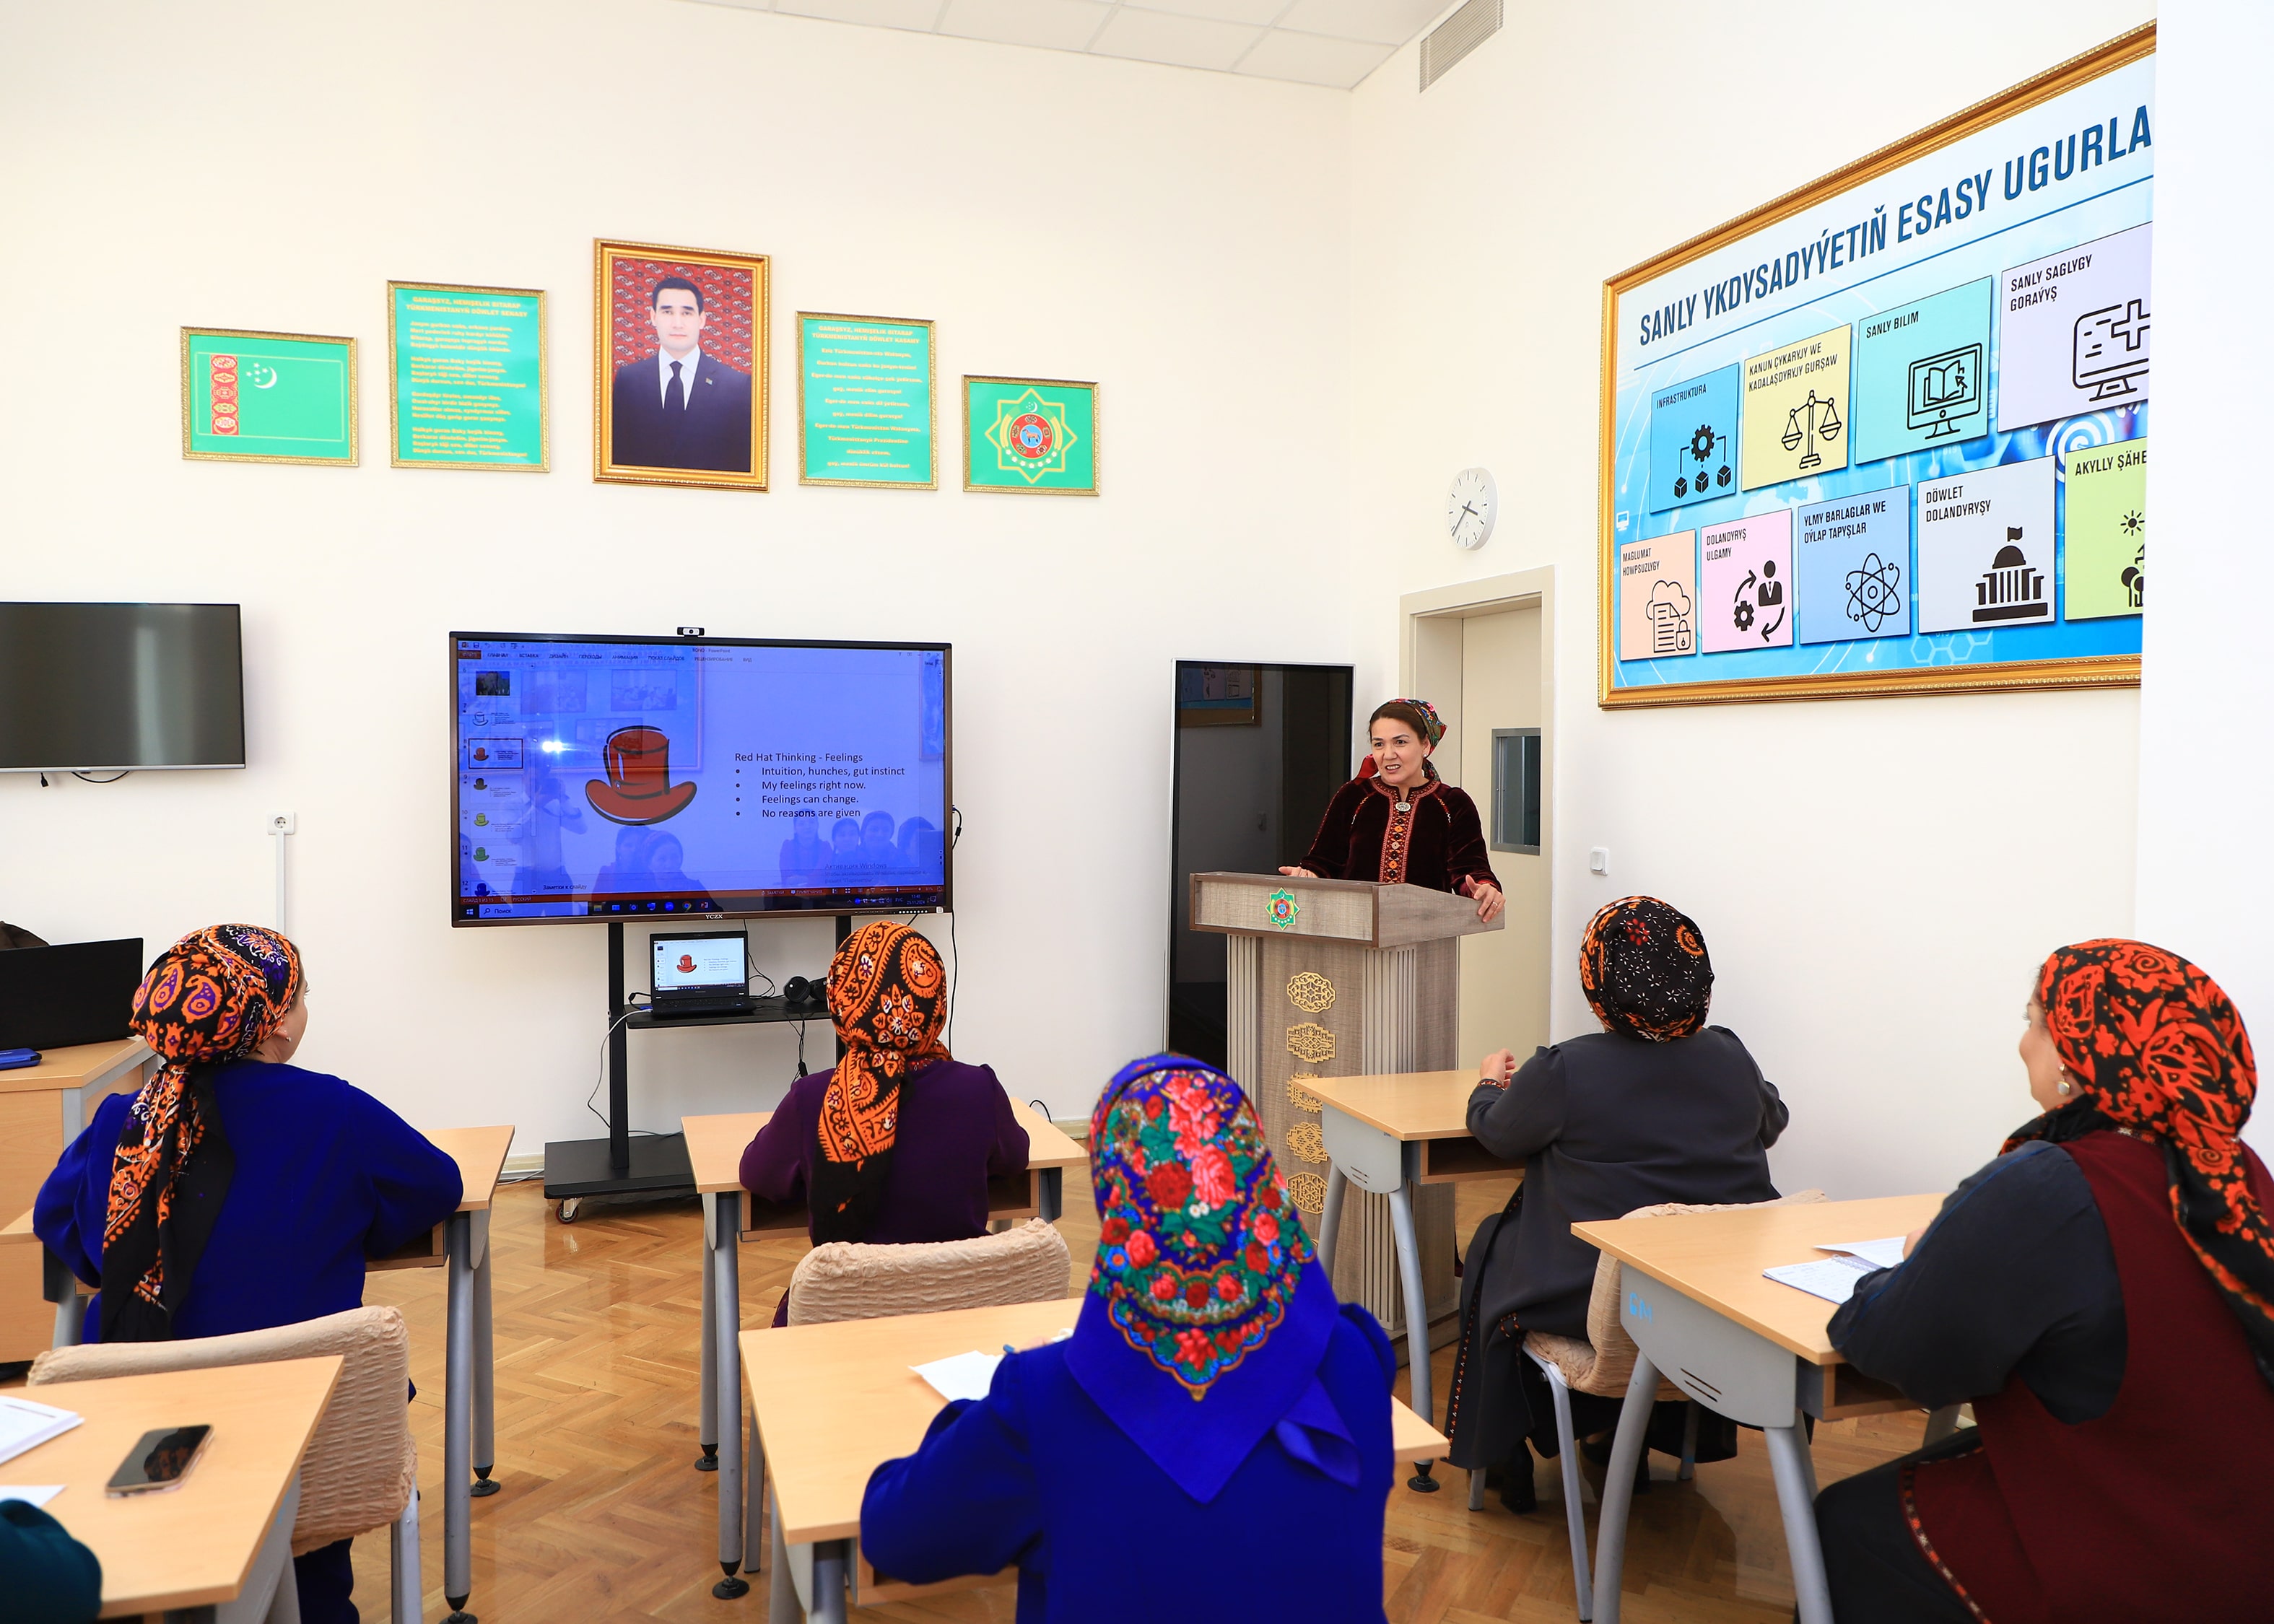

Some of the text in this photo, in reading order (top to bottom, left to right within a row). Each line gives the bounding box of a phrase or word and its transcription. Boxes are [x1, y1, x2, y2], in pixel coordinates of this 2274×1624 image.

[1640, 105, 2151, 346] SANLY YKDYSADYÝETIŇ ESASY UGURLA
[2011, 254, 2092, 292] SANLY SAGLYGY
[2011, 286, 2057, 311] GORAÝYŞ
[1866, 310, 1919, 339] SANLY BILIM
[1749, 342, 1821, 376] KANUN ÇYKARYJY WE
[1749, 354, 1837, 392] KADALAŞDYRYJY GURŞAW
[1657, 383, 1707, 409] INFRASTRUKTURA
[2075, 457, 2114, 476] AKYLLY
[1926, 486, 1964, 503] DÖWLET
[1804, 501, 1886, 526] YLMY BARLAGLAR WE
[1926, 499, 1991, 523] DOLANDYRYŞY
[1707, 528, 1746, 546] DOLANDYRYŞ
[1804, 522, 1866, 543] OÝLAP TAPYŞLAR
[1623, 548, 1651, 562] MAGLUMAT
[1707, 547, 1732, 561] ULGAMY
[1623, 561, 1660, 576] HOWPSUZLYGY
[735, 753, 753, 761] Red
[776, 753, 816, 763] Thinking
[825, 753, 863, 763] Feelings
[762, 767, 806, 777] Intuition,
[809, 767, 851, 777] hunches,
[853, 768, 868, 778] gut
[762, 782, 777, 792] My
[780, 780, 816, 791] feelings
[819, 781, 841, 791] right
[762, 795, 801, 806] Feelings
[822, 795, 859, 805] change.
[836, 808, 861, 818] given
